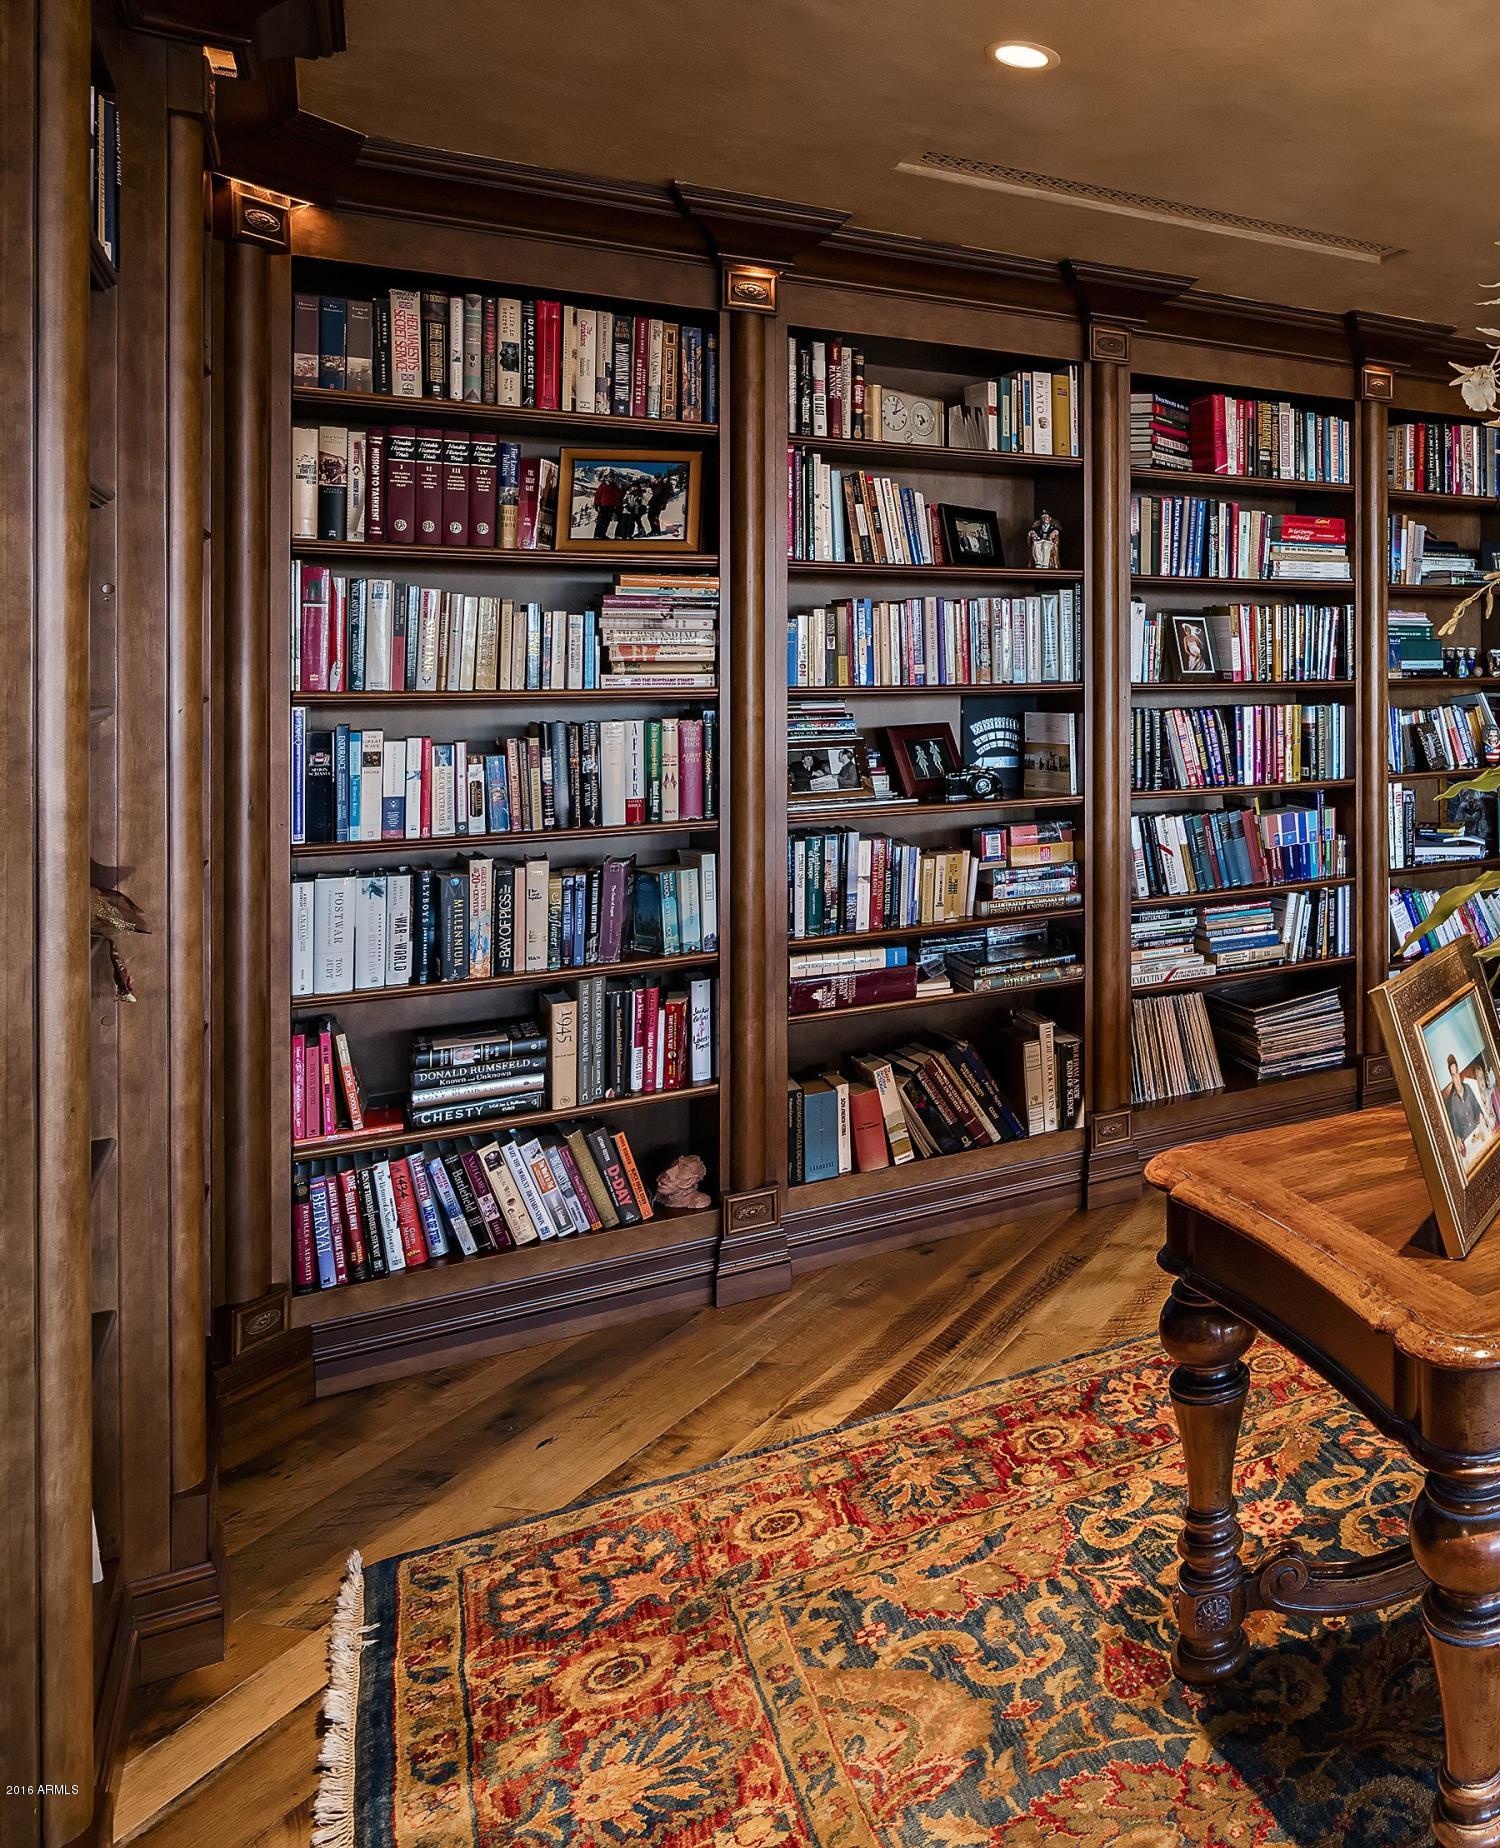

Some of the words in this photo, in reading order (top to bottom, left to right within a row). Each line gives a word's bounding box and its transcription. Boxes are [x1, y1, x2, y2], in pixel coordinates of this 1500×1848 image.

[394, 308, 406, 340] SECRET
[406, 314, 418, 330] HER
[579, 320, 588, 347] Canadians
[396, 340, 408, 372] SERVICE
[406, 330, 420, 372] MAJESTYS
[527, 339, 534, 352] OF
[615, 342, 629, 352] NO
[615, 352, 629, 385] ORDINARY
[615, 385, 629, 401] TIME
[828, 365, 836, 399] PLANNING
[1035, 380, 1045, 414] PLATO
[1262, 403, 1272, 451] MANAGEMENT
[371, 447, 380, 475] MISSION
[390, 445, 415, 453] Historical
[418, 447, 442, 455] Historical
[445, 449, 469, 457] Historical
[473, 451, 496, 459] Historical
[371, 475, 380, 487] TO
[371, 487, 380, 522] TASHKENT
[338, 735, 346, 770] ENDURANCE
[438, 768, 446, 783] AGE
[584, 782, 591, 791] AT
[438, 791, 446, 826] EXTREMES
[813, 852, 821, 889] Architecture
[421, 877, 429, 924] FLYBOYS
[499, 894, 512, 917] PIGS
[990, 905, 1026, 915] ESSENTIAL
[333, 891, 344, 944] POSTWAR
[394, 916, 408, 935] WAR
[499, 917, 511, 937] OF
[550, 892, 562, 947] Mayflower
[453, 899, 464, 967] MILLENNIUM
[394, 942, 407, 972] WORLD
[499, 937, 511, 959] BAY
[335, 958, 343, 978] TONY
[1132, 974, 1164, 985] EXECUTIVE
[555, 1010, 573, 1043] 1945
[582, 1013, 589, 1022] OF
[419, 1067, 468, 1082] DONALD
[469, 1059, 531, 1075] RUMSFELD
[439, 1075, 467, 1086] Known
[476, 1071, 512, 1081] Unknown
[1066, 1060, 1074, 1078] KIND
[1066, 1078, 1074, 1087] OF
[421, 1106, 484, 1124] CHESTY
[1066, 1088, 1074, 1118] SCIENCE
[328, 1182, 338, 1207] AMERICA
[346, 1175, 357, 1191] ONE
[394, 1175, 409, 1199] 1434
[451, 1168, 476, 1213] Battlefield
[606, 1163, 633, 1206] D-DAY
[344, 1191, 357, 1215] BULLET
[311, 1191, 331, 1257] BETRAYAL
[349, 1214, 358, 1231] AWAY
[304, 1247, 312, 1281] AUDACITY
